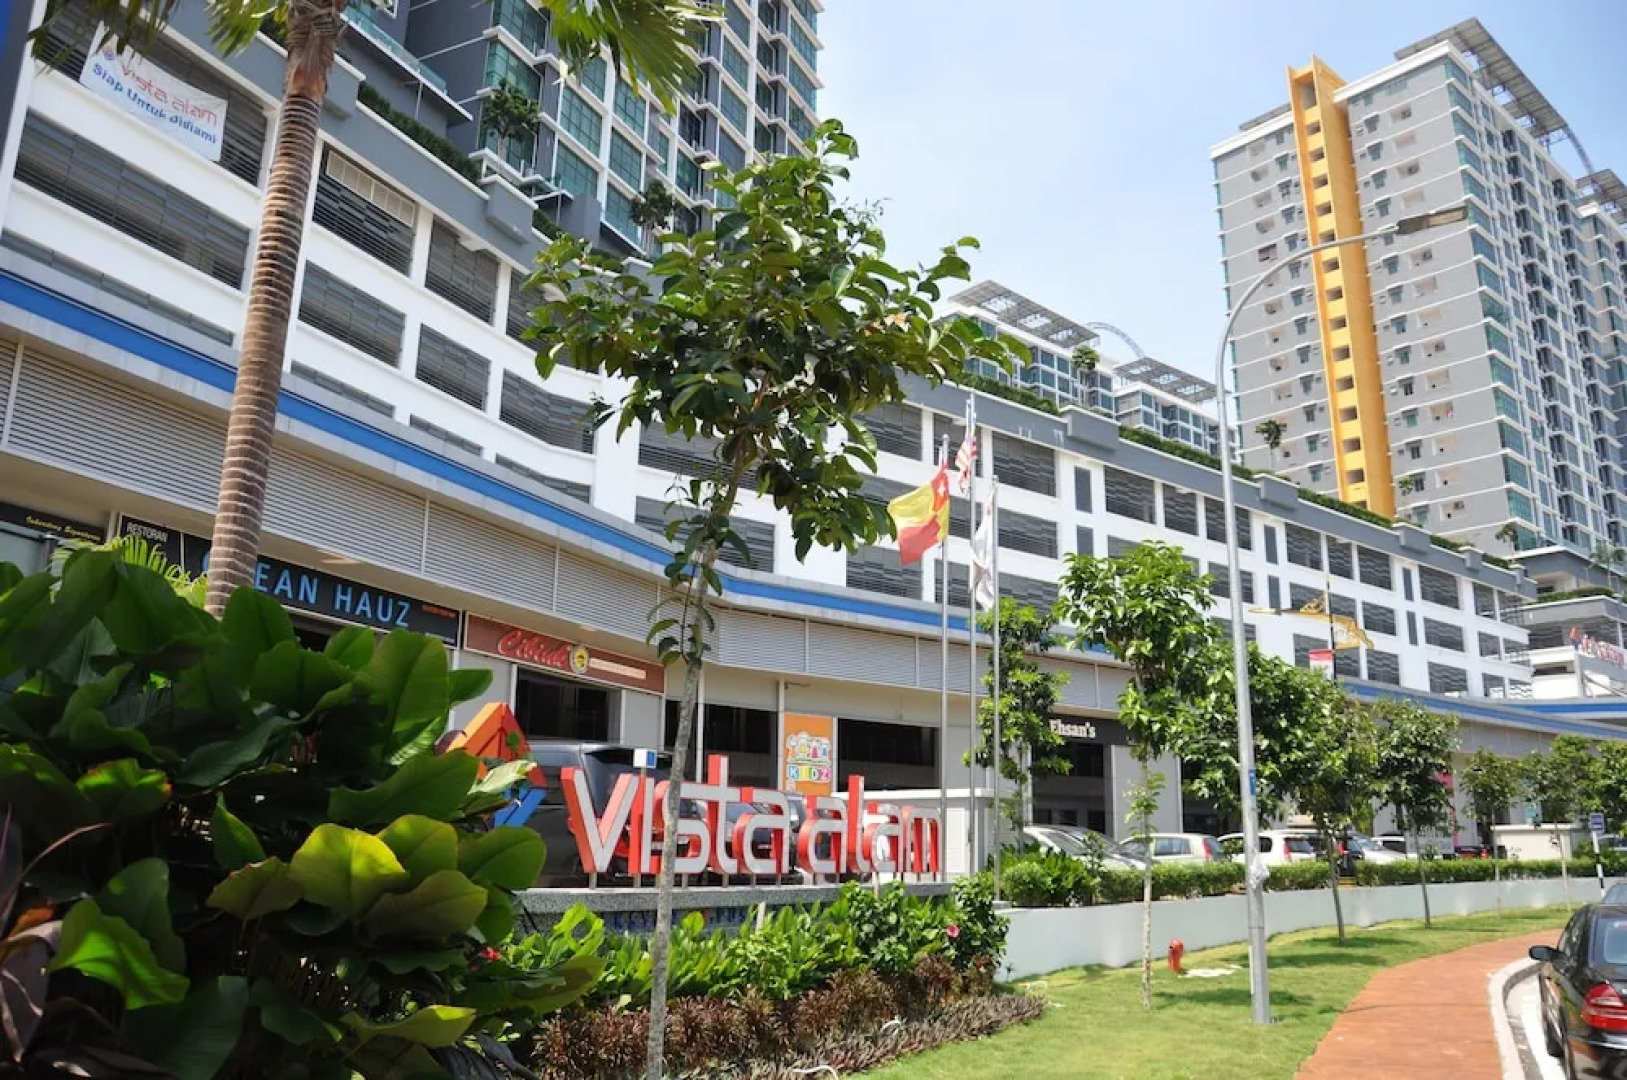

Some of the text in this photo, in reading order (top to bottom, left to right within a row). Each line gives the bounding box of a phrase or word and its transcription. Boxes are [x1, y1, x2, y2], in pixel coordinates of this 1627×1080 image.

[93, 63, 217, 144] Siap Untuk didiami
[171, 97, 218, 126] alam
[126, 522, 169, 543] RESTORAN
[203, 552, 411, 627] EAN HAUZ
[1049, 719, 1096, 738] Ehsan's
[800, 774, 941, 874] alam
